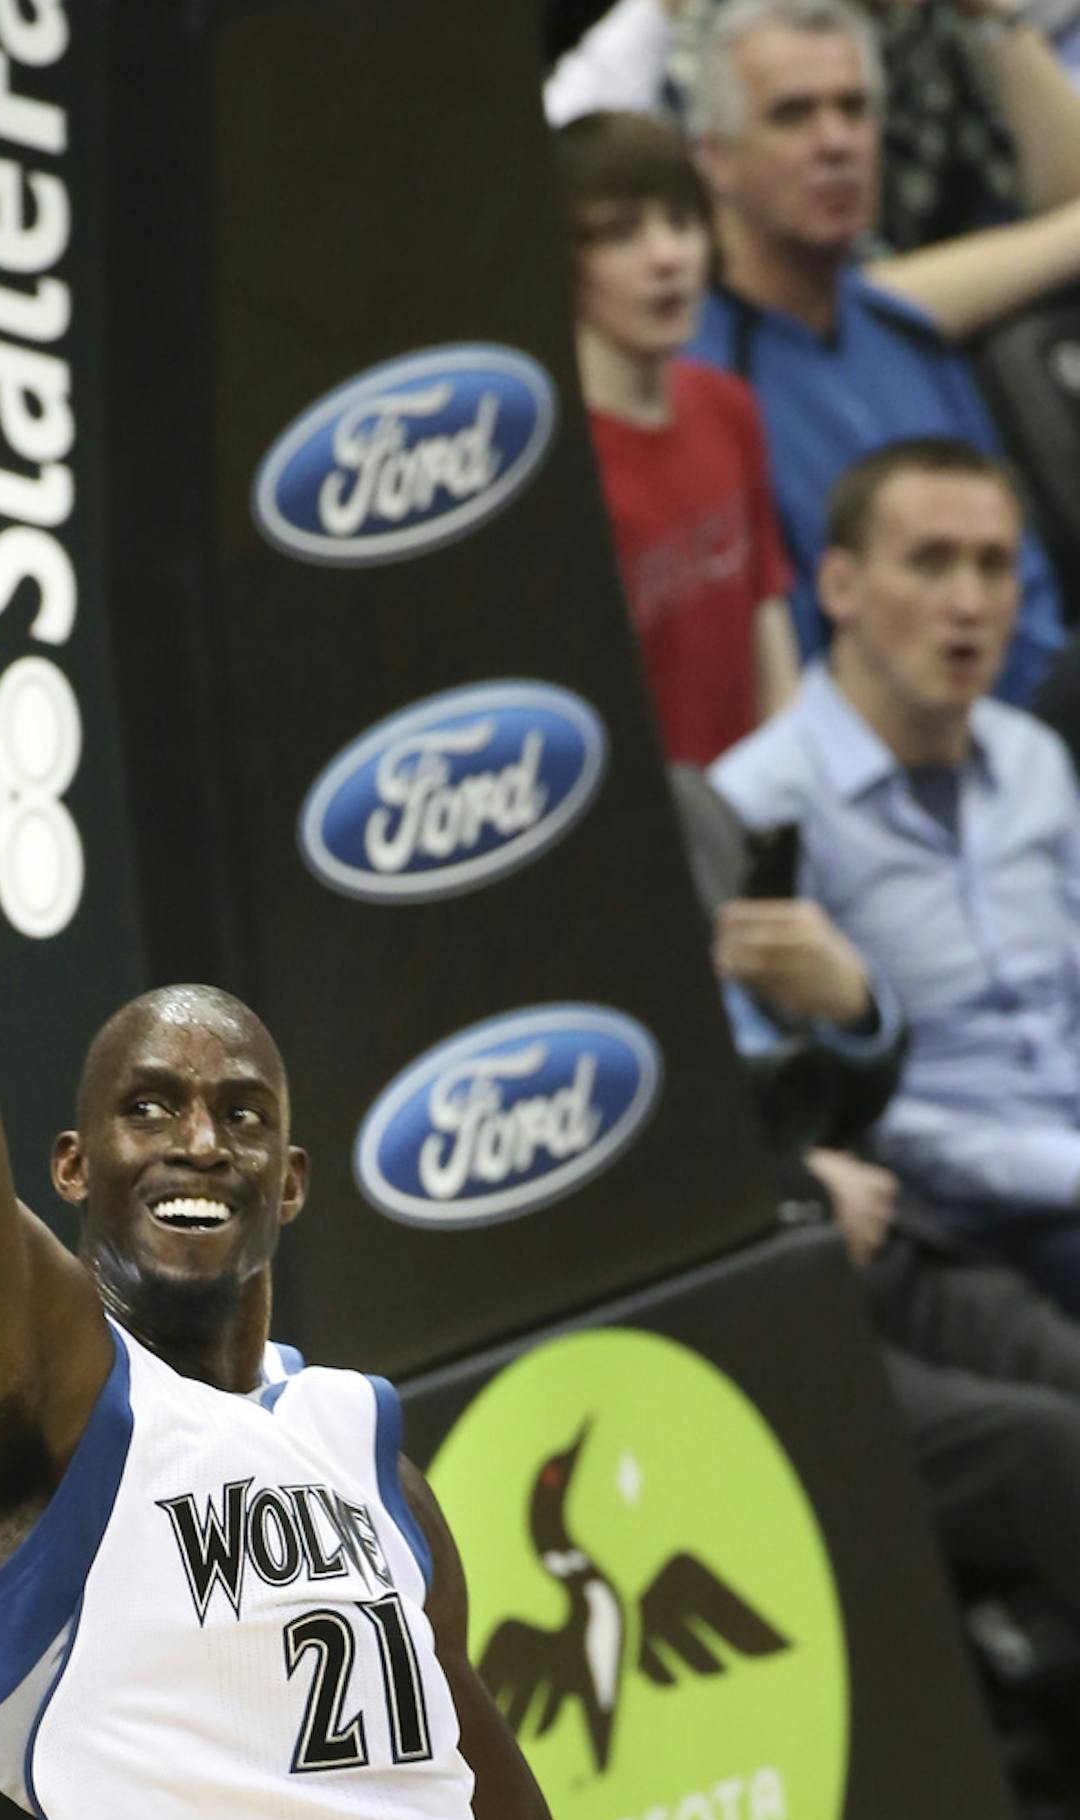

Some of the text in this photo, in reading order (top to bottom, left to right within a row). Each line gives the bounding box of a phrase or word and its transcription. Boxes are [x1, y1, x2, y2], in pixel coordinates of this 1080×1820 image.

[319, 382, 503, 537] Ford
[365, 716, 550, 873] Ford
[419, 1040, 604, 1199] Ford
[283, 1593, 433, 1774] 21
